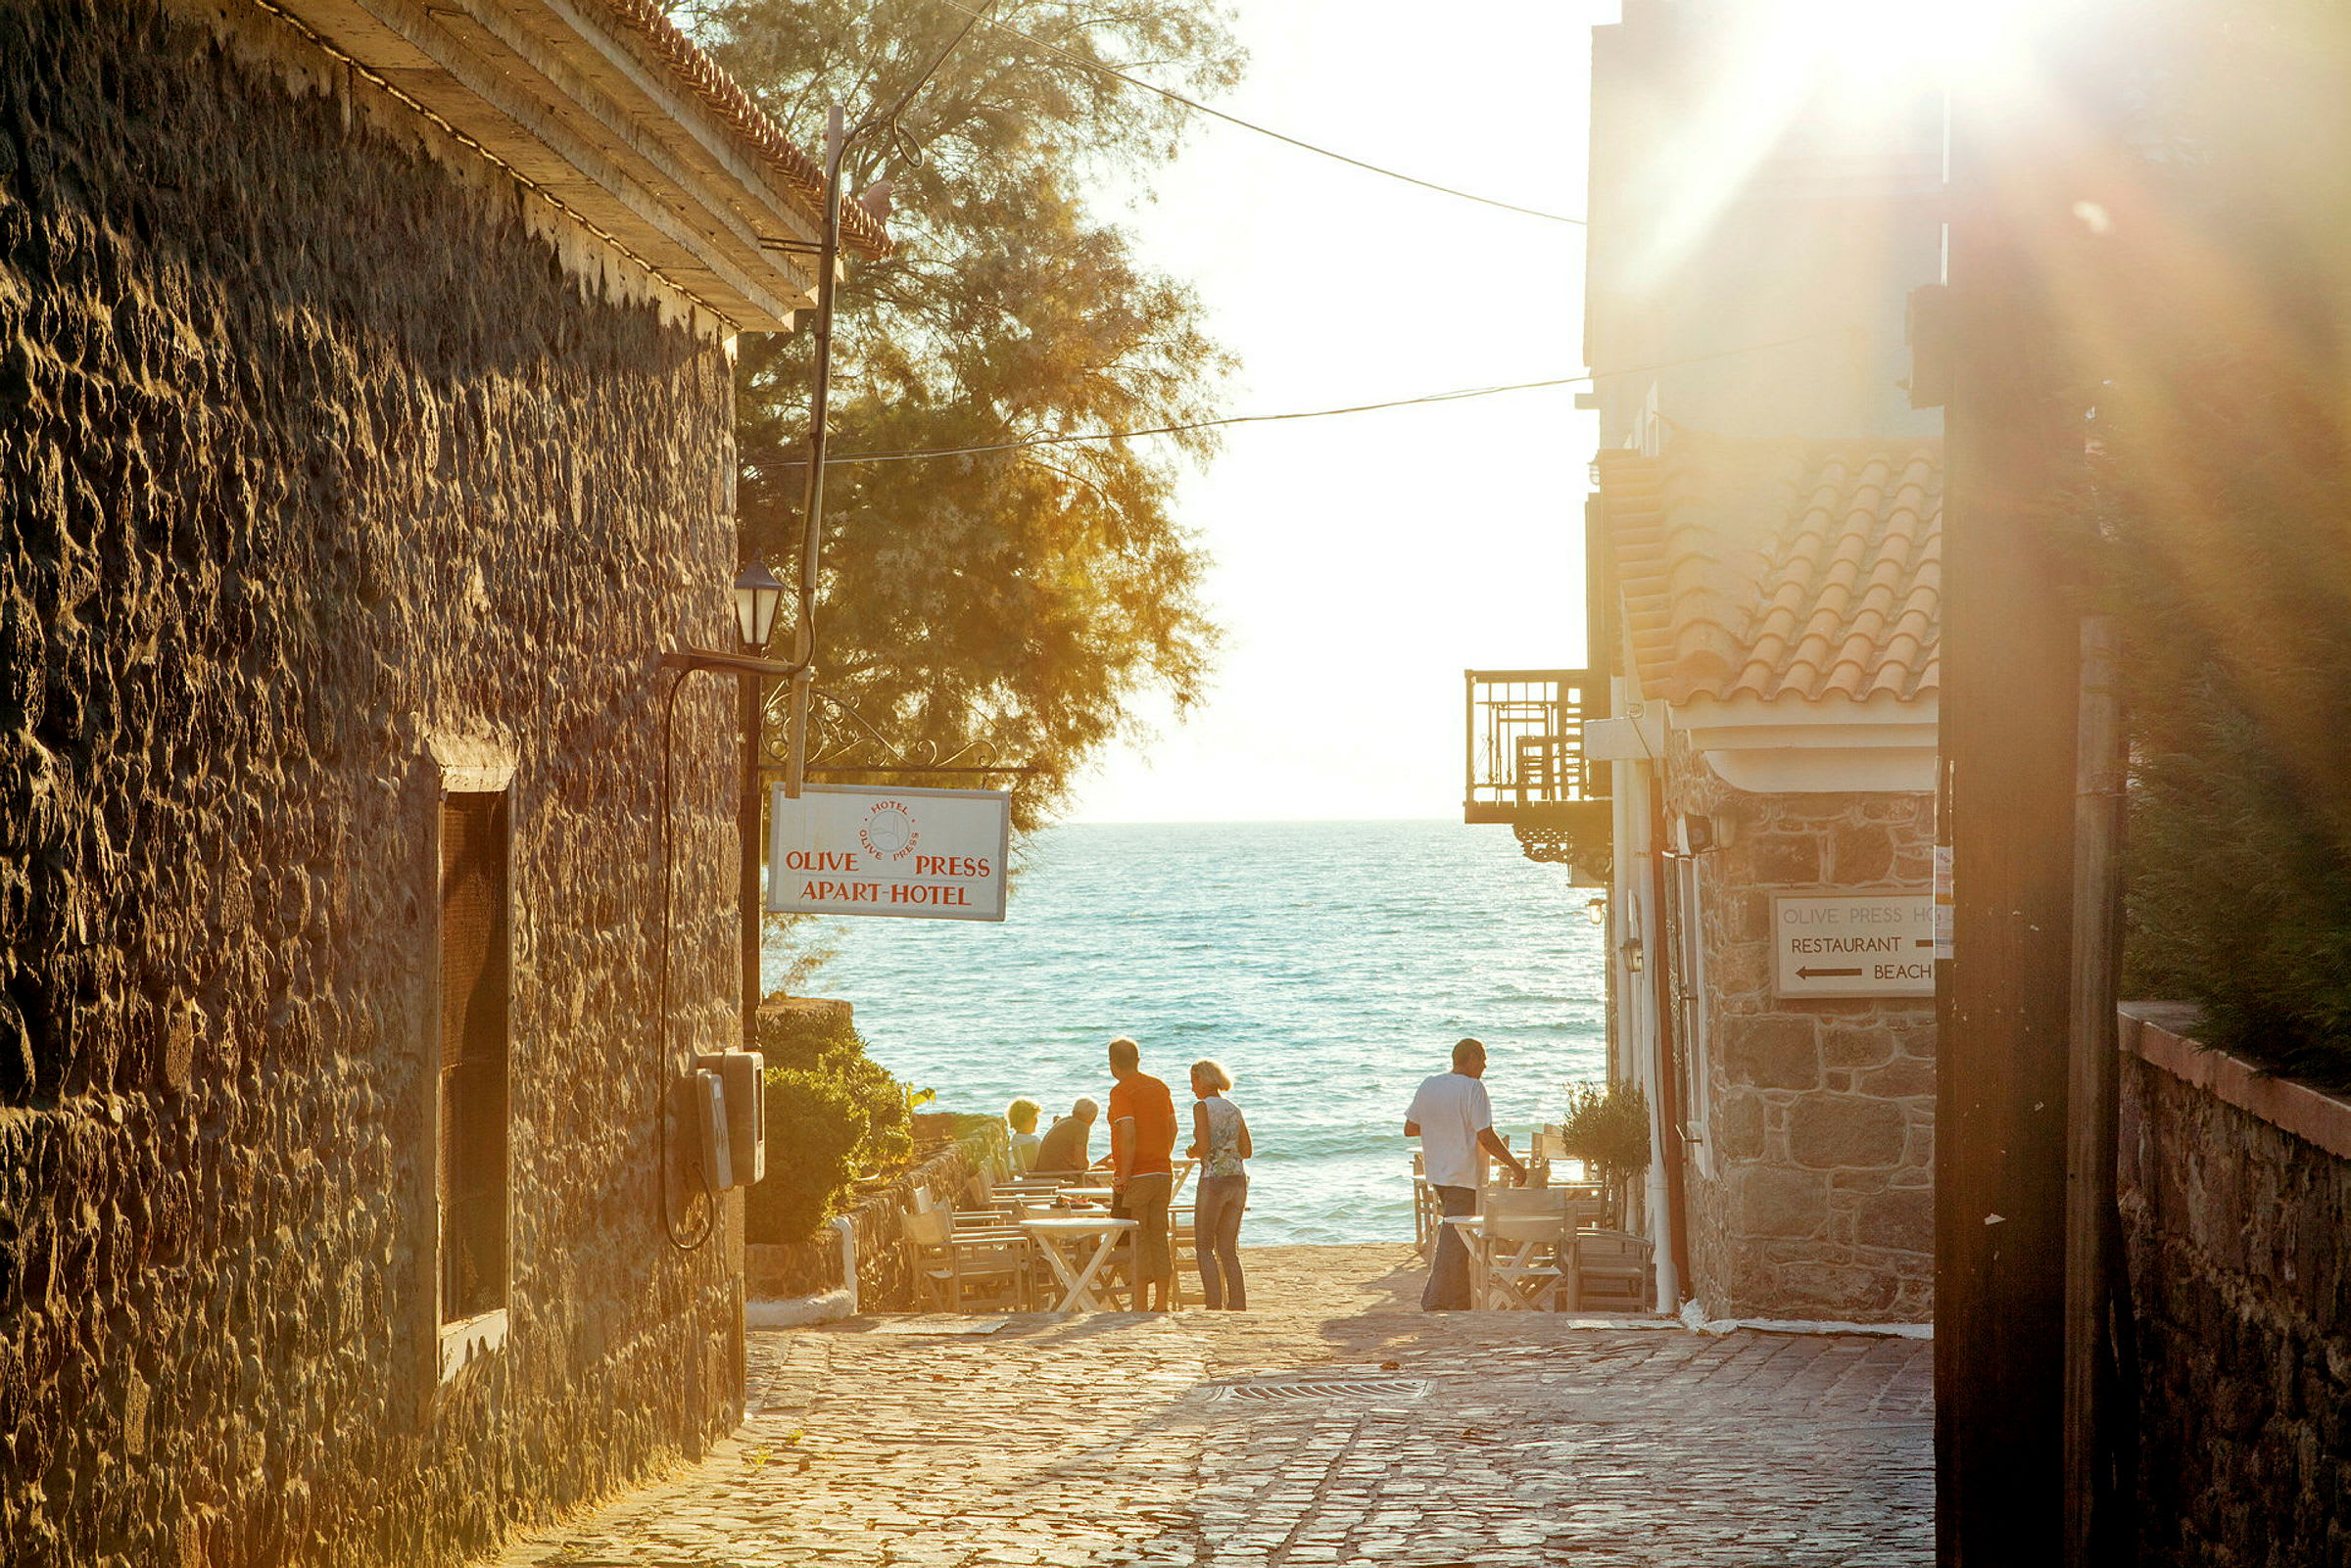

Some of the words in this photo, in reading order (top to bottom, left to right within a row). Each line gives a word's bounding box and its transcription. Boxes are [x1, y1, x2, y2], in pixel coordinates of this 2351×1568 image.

[871, 800, 909, 815] HOTEL
[859, 830, 884, 860] OLIVE
[892, 832, 920, 861] PRESS
[786, 850, 859, 872] OLIVE
[915, 855, 991, 878] PRESS
[799, 880, 972, 906] APART-HOTEL
[1783, 908, 1840, 925] OLIVE
[1849, 907, 1902, 924] PRESS
[1791, 936, 1902, 954] RESTAURANT
[1874, 964, 1932, 979] BEACH
